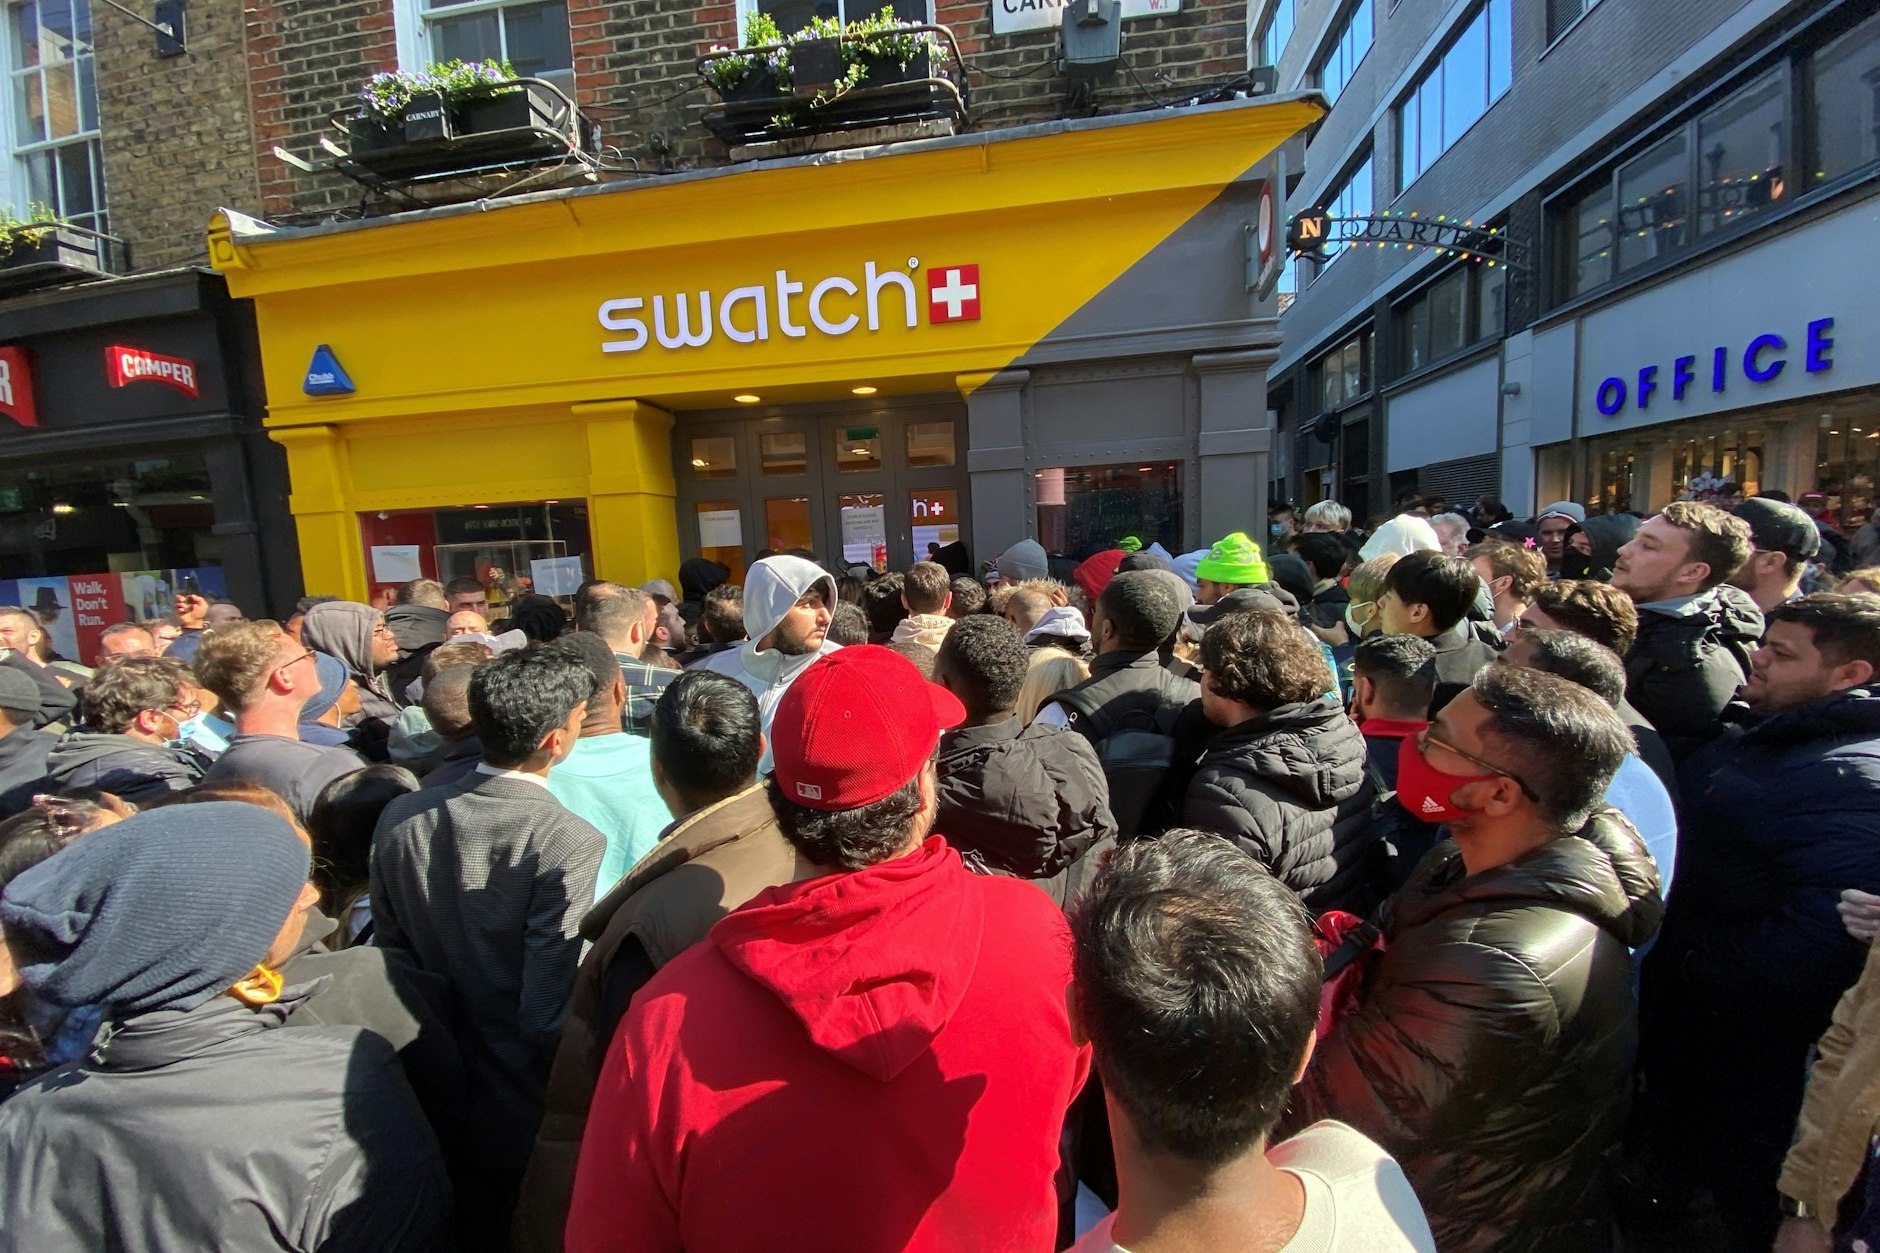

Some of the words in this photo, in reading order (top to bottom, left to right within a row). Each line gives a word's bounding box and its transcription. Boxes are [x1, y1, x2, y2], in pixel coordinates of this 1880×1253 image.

[405, 109, 440, 122] CARNABY
[1299, 216, 1323, 239] N
[598, 261, 918, 353] swatch
[121, 353, 195, 389] CAMPER
[1596, 317, 1835, 416] OFFICE
[73, 581, 107, 596] Walk,
[76, 597, 108, 611] Don't
[78, 613, 106, 626] Run.
